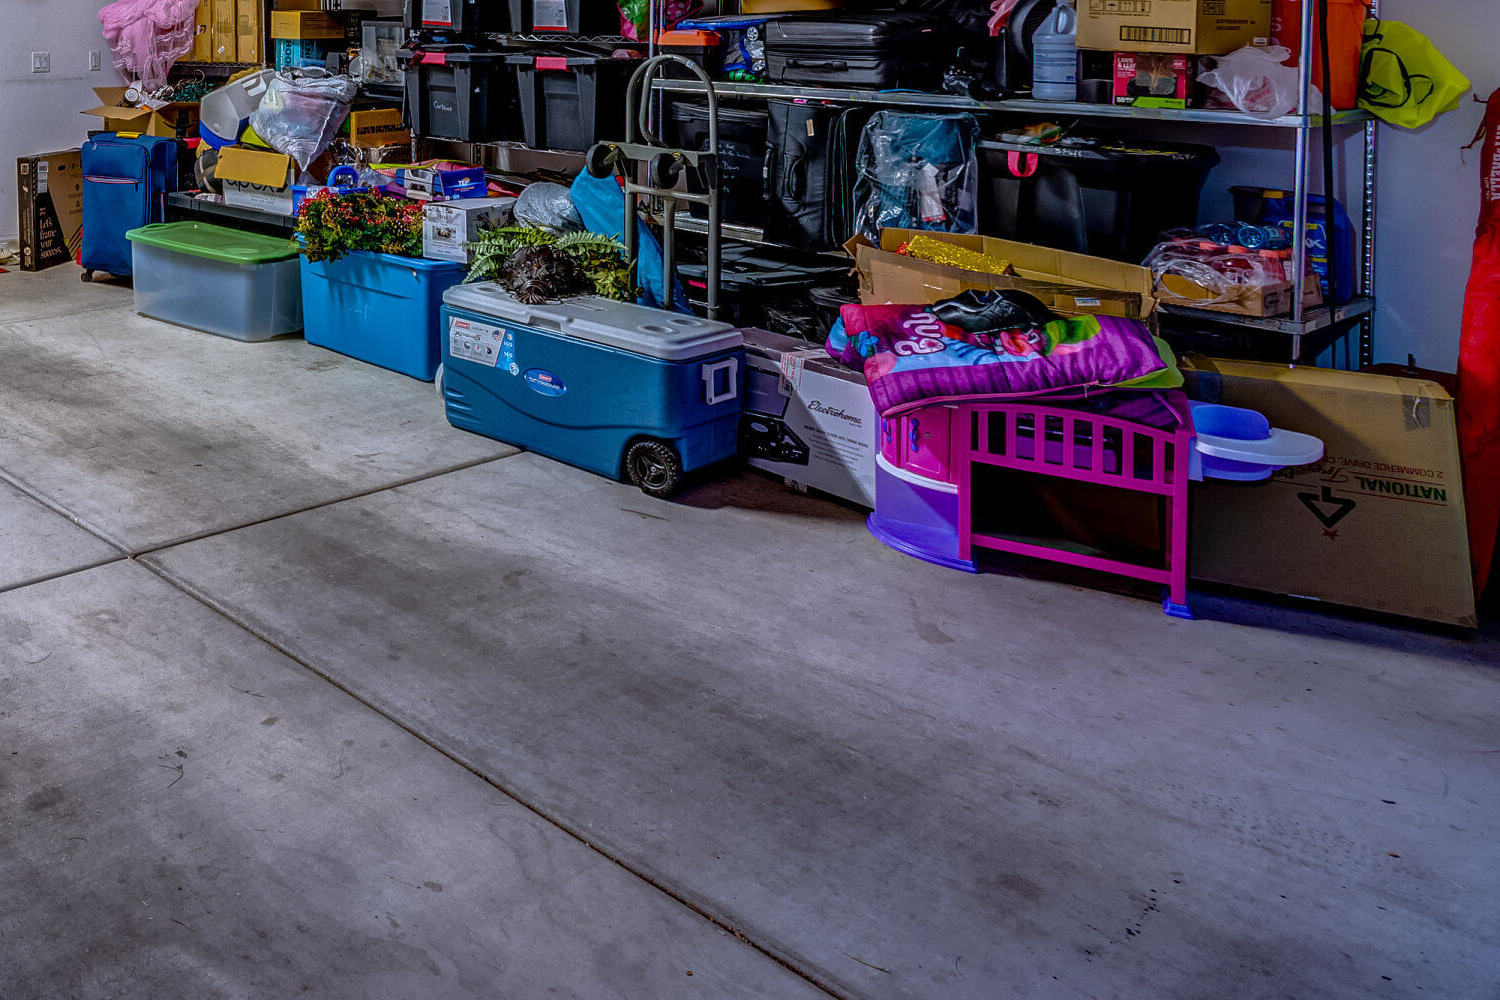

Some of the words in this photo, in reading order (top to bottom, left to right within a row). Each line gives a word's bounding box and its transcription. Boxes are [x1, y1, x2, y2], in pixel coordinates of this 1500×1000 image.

[808, 400, 862, 424] Electrohome
[1373, 461, 1435, 479] COMMERCE
[1354, 476, 1447, 501] NATIONAL
